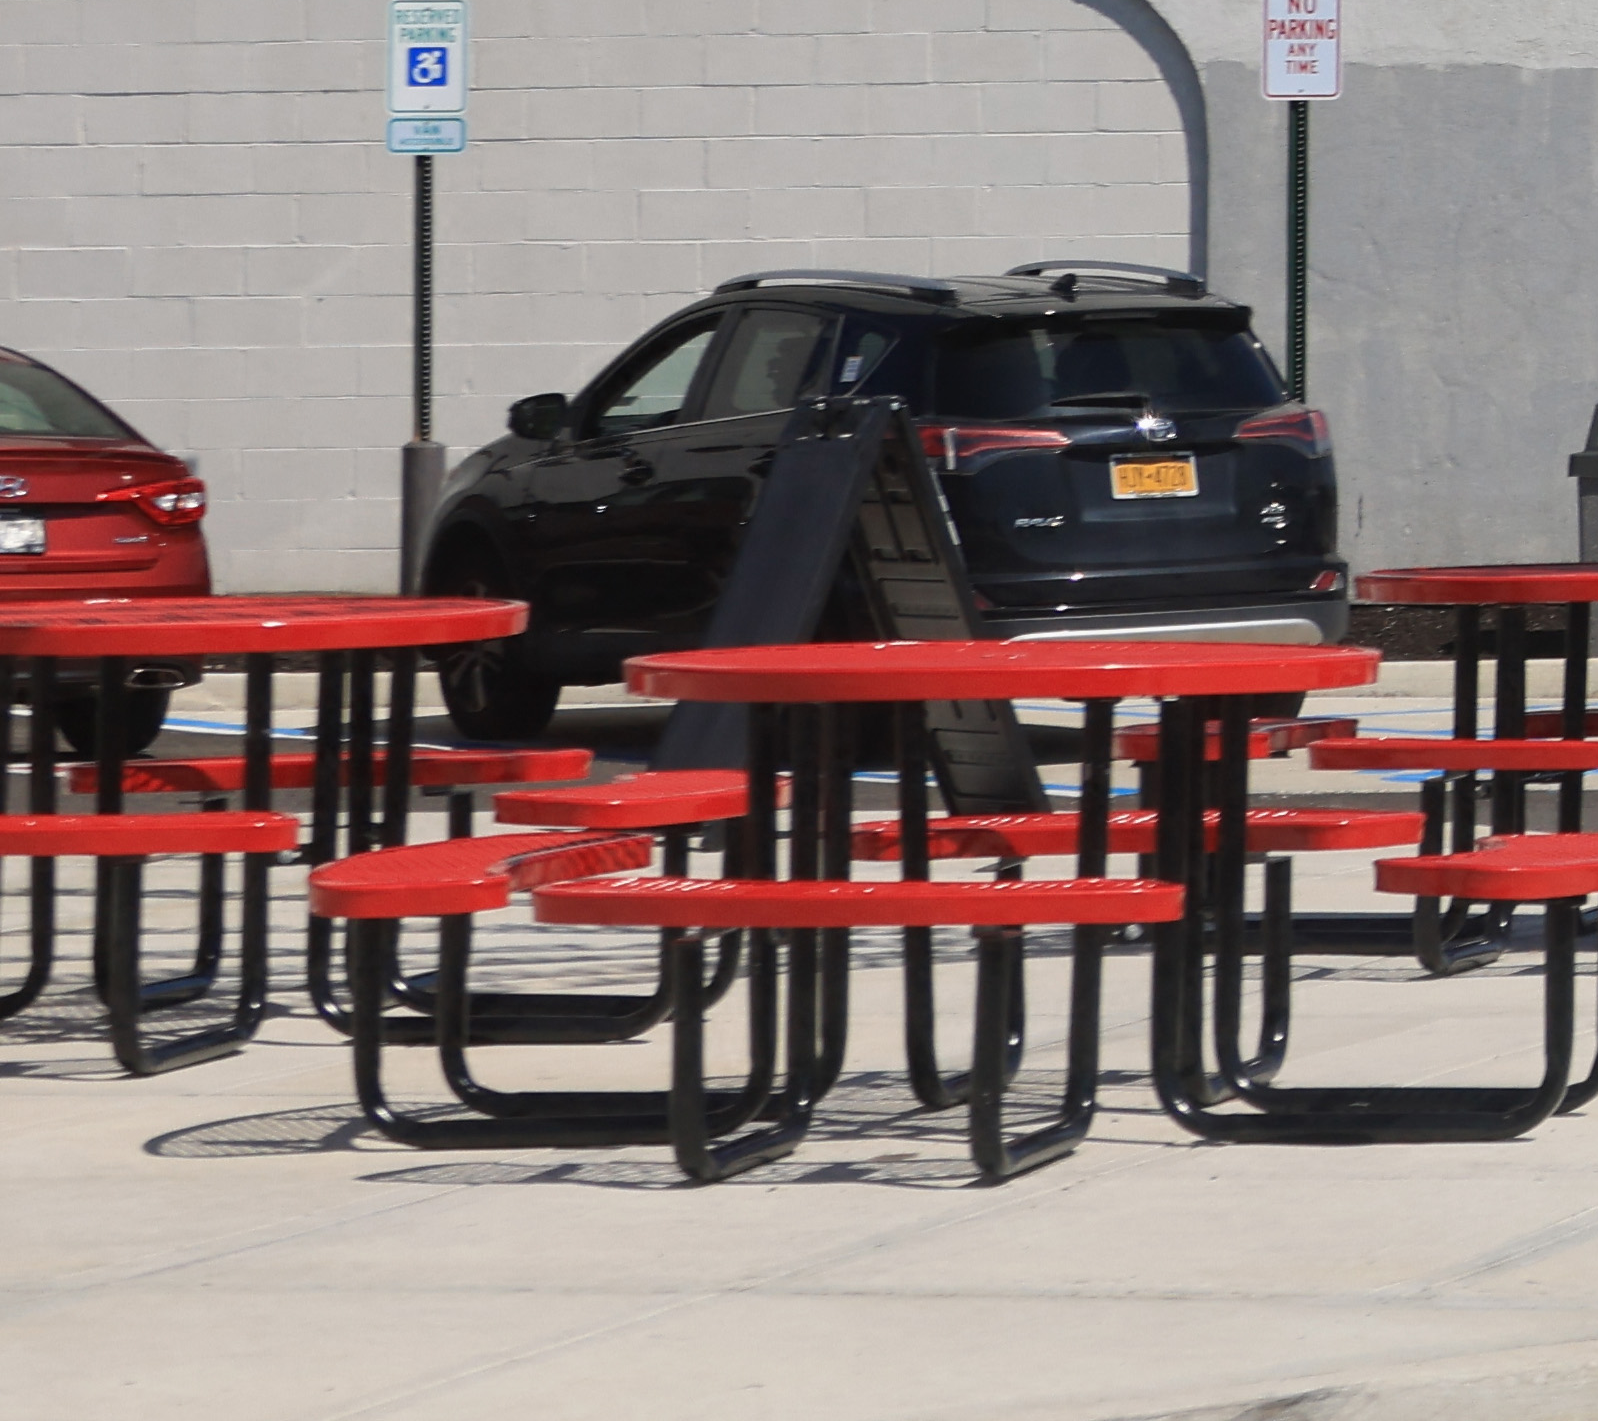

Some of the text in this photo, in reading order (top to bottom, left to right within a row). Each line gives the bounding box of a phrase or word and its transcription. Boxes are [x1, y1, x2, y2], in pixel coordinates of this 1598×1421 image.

[1266, 19, 1337, 39] PARKING
[1287, 43, 1318, 57] ANY
[1285, 60, 1319, 74] TIME
